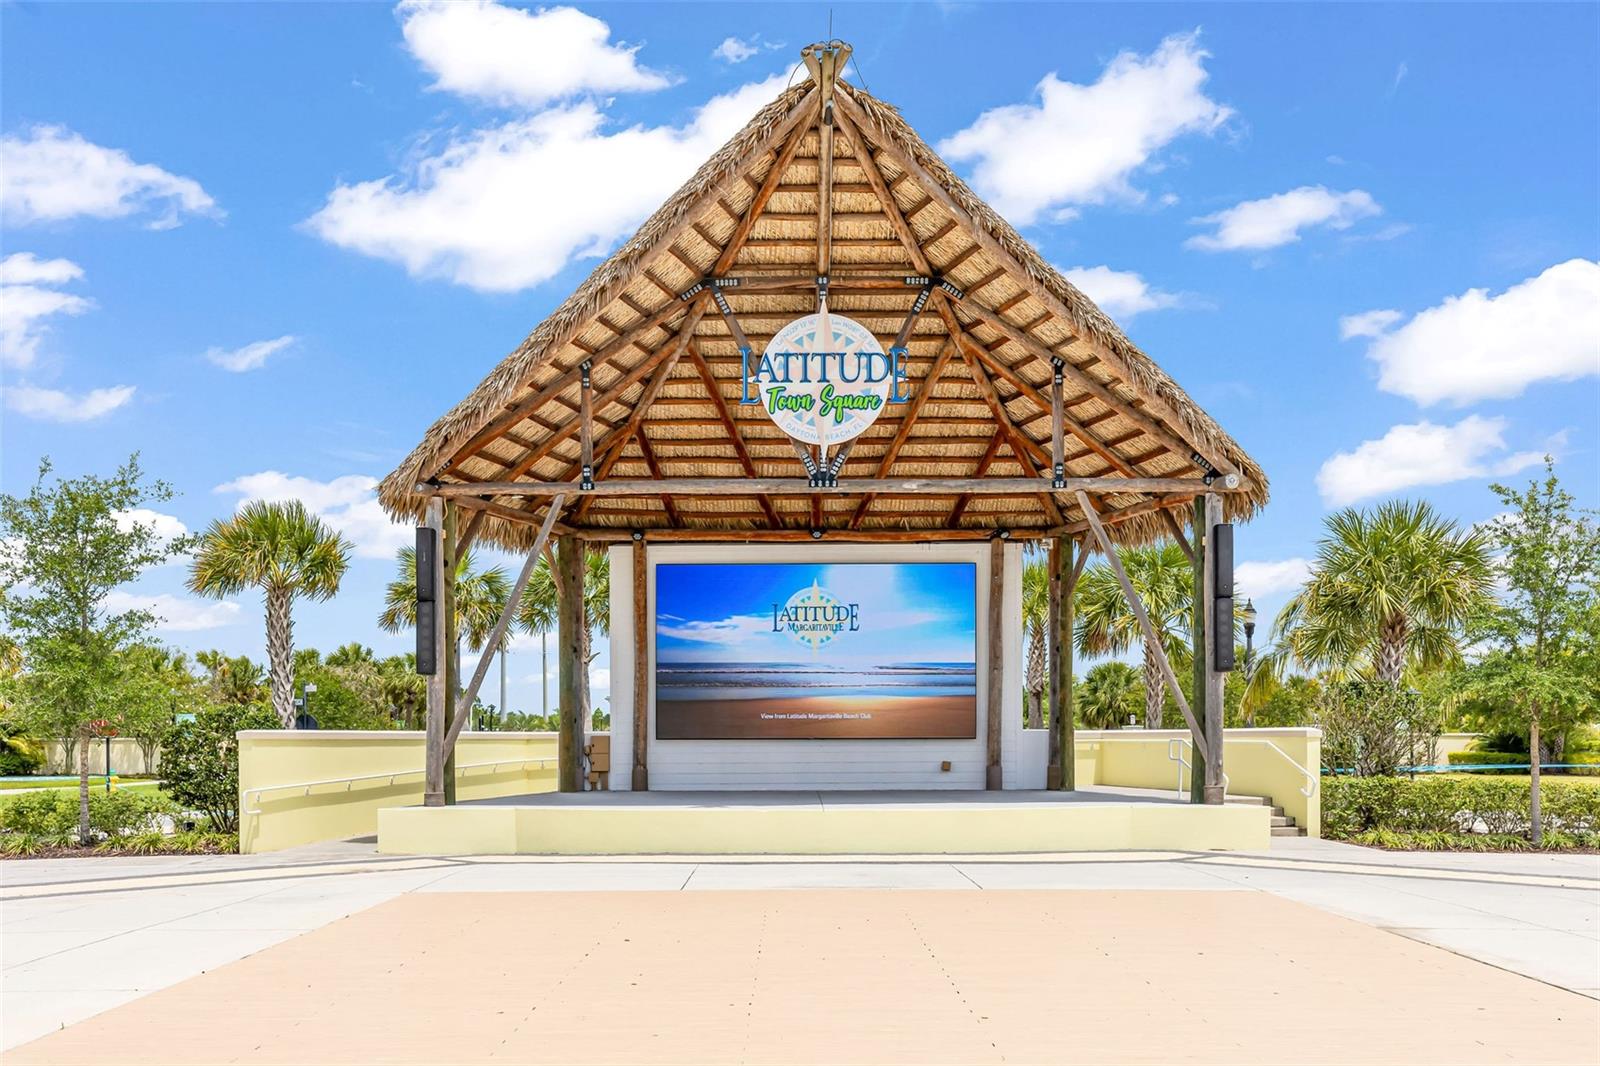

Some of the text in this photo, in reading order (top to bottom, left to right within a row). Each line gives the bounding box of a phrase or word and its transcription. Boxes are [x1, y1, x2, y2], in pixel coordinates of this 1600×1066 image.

[739, 347, 911, 405] LATITUDE
[767, 384, 882, 423] Town Square
[786, 422, 820, 440] DAYTONA
[772, 603, 860, 632] LATITUDE
[787, 622, 844, 632] MARGARITAVILLE
[808, 712, 842, 720] Margaritaville
